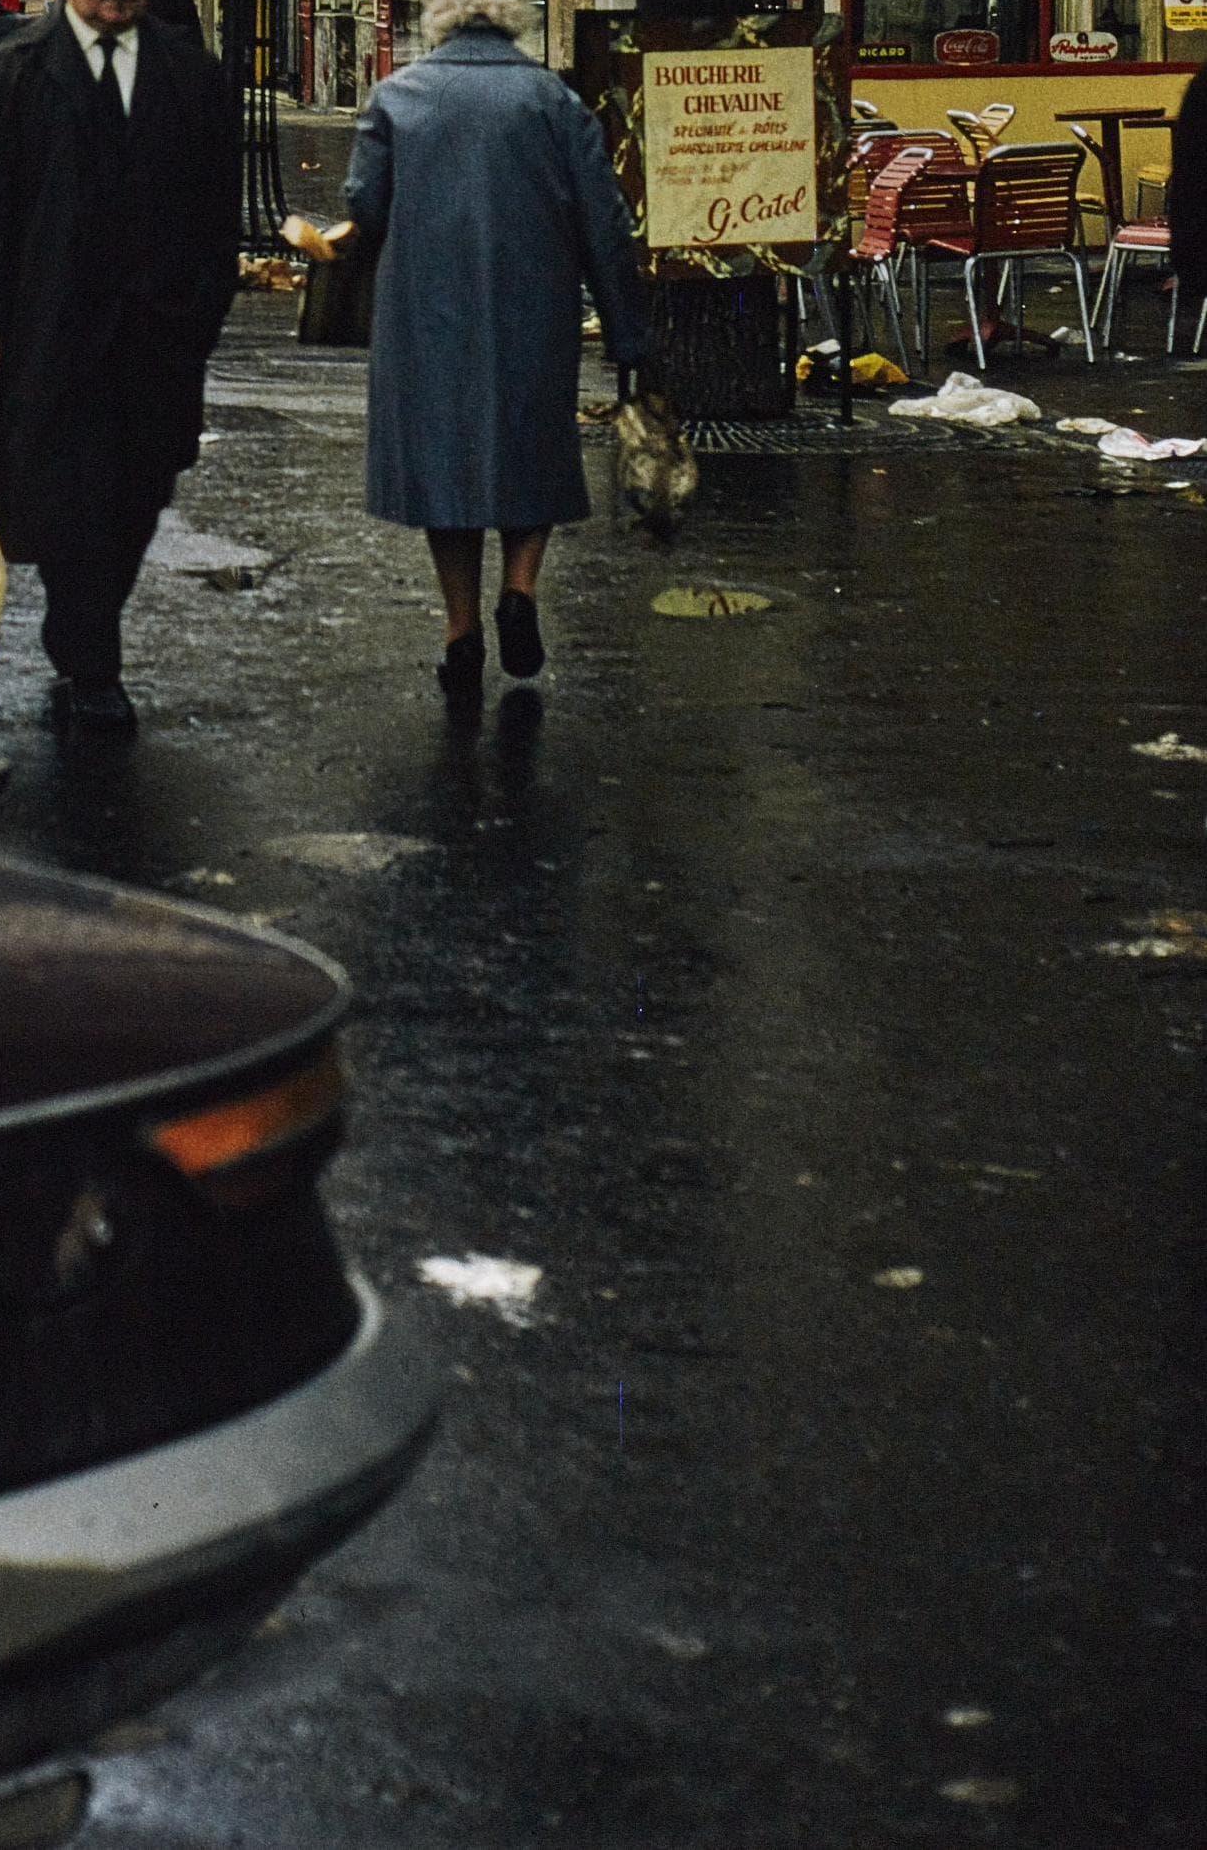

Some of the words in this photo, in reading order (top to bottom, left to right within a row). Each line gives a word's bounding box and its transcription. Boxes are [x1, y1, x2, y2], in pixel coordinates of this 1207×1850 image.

[858, 46, 906, 58] RICARD
[655, 65, 765, 87] BOUCHERIE
[684, 92, 785, 115] CHEVALINE
